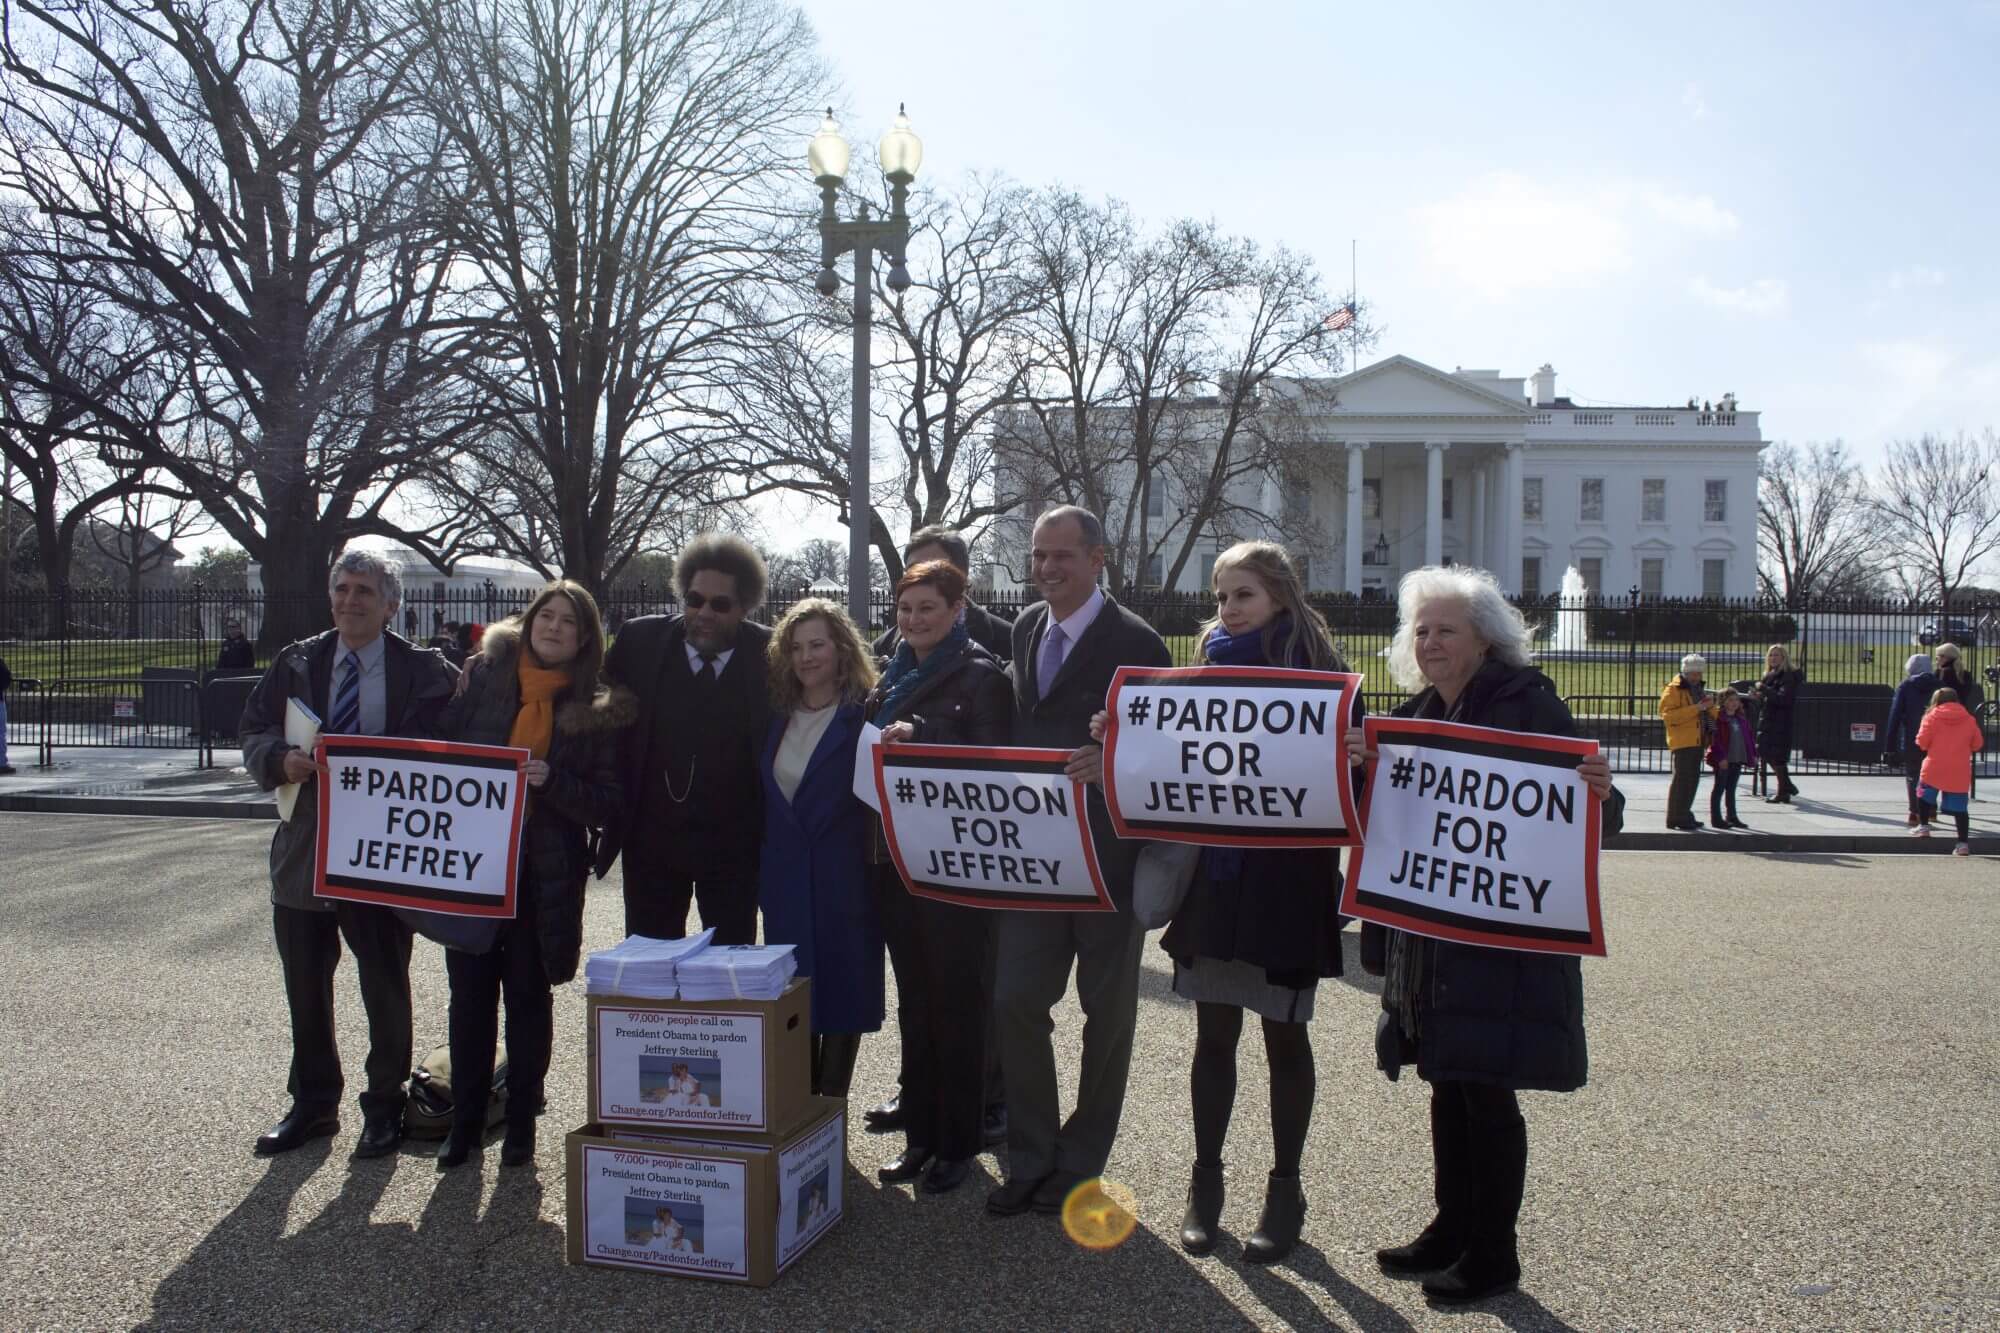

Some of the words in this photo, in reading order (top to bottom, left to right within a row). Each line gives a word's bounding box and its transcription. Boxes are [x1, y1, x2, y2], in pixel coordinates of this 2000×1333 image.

[1127, 695, 1328, 735] #PARDON
[1181, 741, 1263, 777] FOR
[340, 766, 508, 810] #PARDON
[895, 777, 1068, 817] #PARDON
[1144, 781, 1308, 818] JEFFREY
[1389, 756, 1575, 825] #PARDON
[386, 806, 453, 841] FOR
[951, 816, 1023, 850] FOR
[1432, 811, 1507, 862] FOR
[349, 839, 484, 881] JEFFREY
[927, 850, 1061, 886] JEFFREY
[1389, 850, 1552, 914] JEFFREY
[615, 1028, 660, 1038] President
[662, 1030, 698, 1041] Obama
[699, 1031, 710, 1041] to
[712, 1032, 748, 1043] pardon
[628, 1013, 665, 1024] 97,000+
[667, 1015, 699, 1026] people
[700, 1017, 718, 1026] call
[720, 1019, 734, 1027] on
[644, 1045, 677, 1056] Jeffrey
[680, 1046, 719, 1058] Sterling
[610, 1104, 752, 1121] Change.org/PardonforJeffrey
[602, 1167, 645, 1181] President
[647, 1171, 682, 1185] Obama
[684, 1175, 694, 1186] to
[695, 1176, 730, 1189] pardon
[614, 1153, 650, 1165] 97,000+
[652, 1157, 683, 1170] people
[684, 1161, 701, 1172] call
[703, 1164, 717, 1173] on
[629, 1186, 662, 1200] Jeffrey
[663, 1188, 702, 1202] Sterling
[597, 1244, 735, 1270] Change.org/PardonforJeffrey
